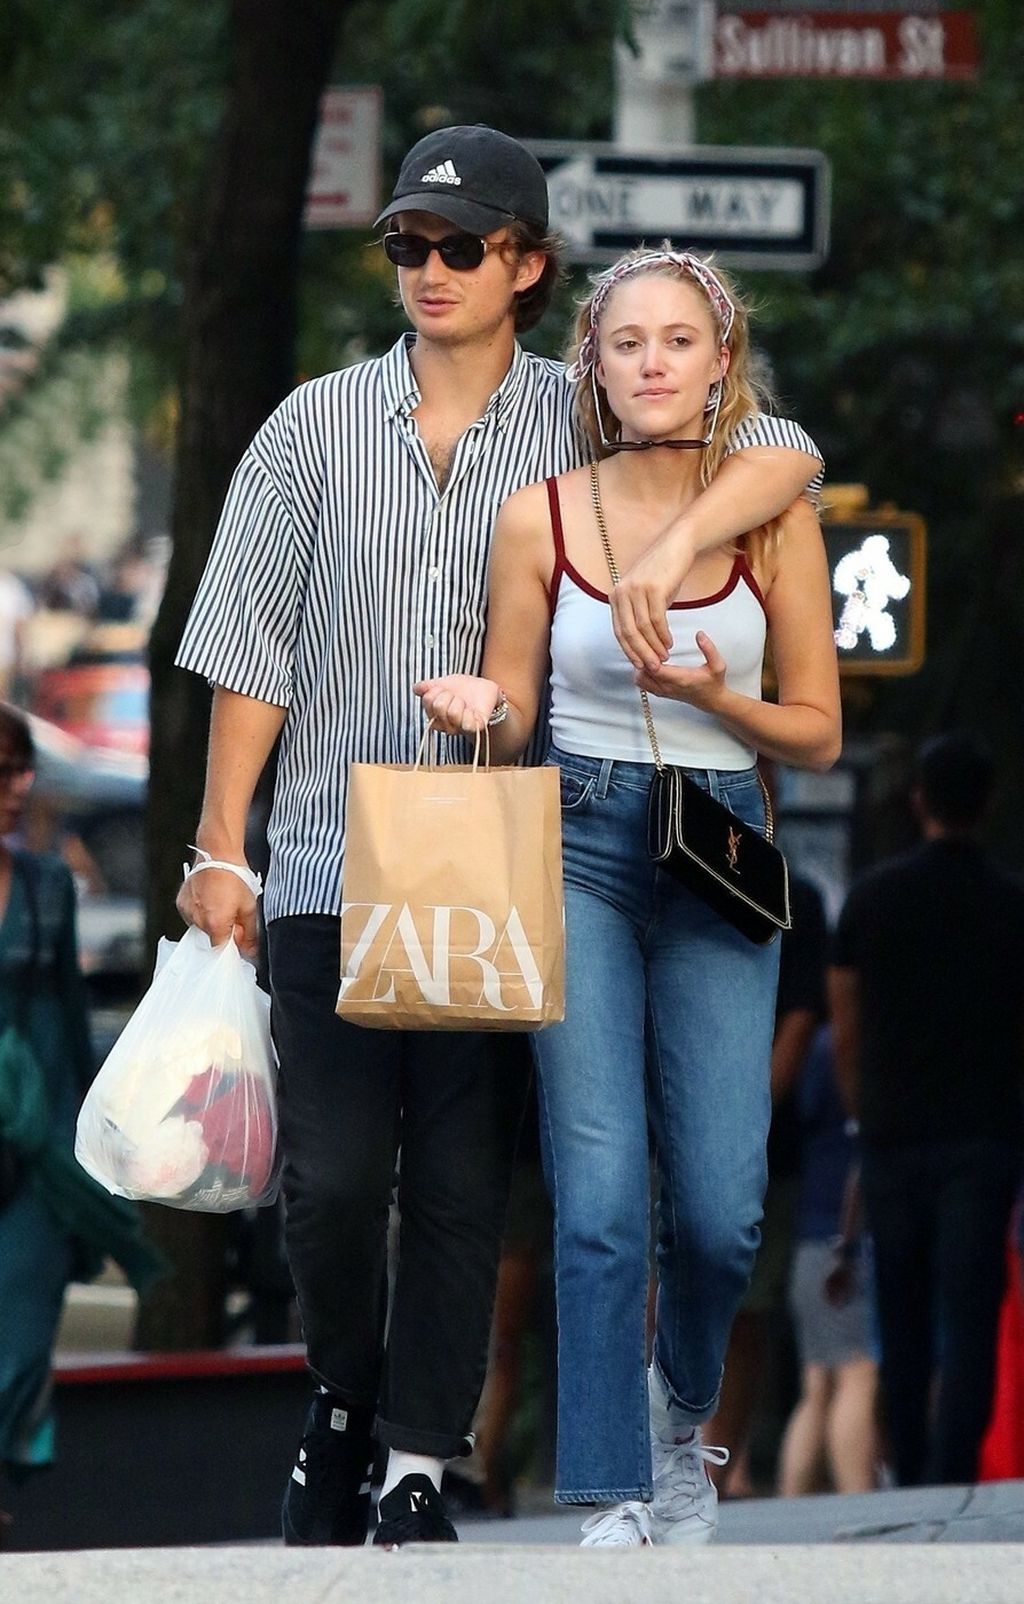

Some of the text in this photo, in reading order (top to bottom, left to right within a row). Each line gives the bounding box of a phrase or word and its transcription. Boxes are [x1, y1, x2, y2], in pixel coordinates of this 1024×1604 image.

[718, 14, 945, 76] Sullivan St
[421, 172, 462, 186] adidas
[553, 179, 782, 228] ONE WAY
[338, 902, 544, 1011] ZARA
